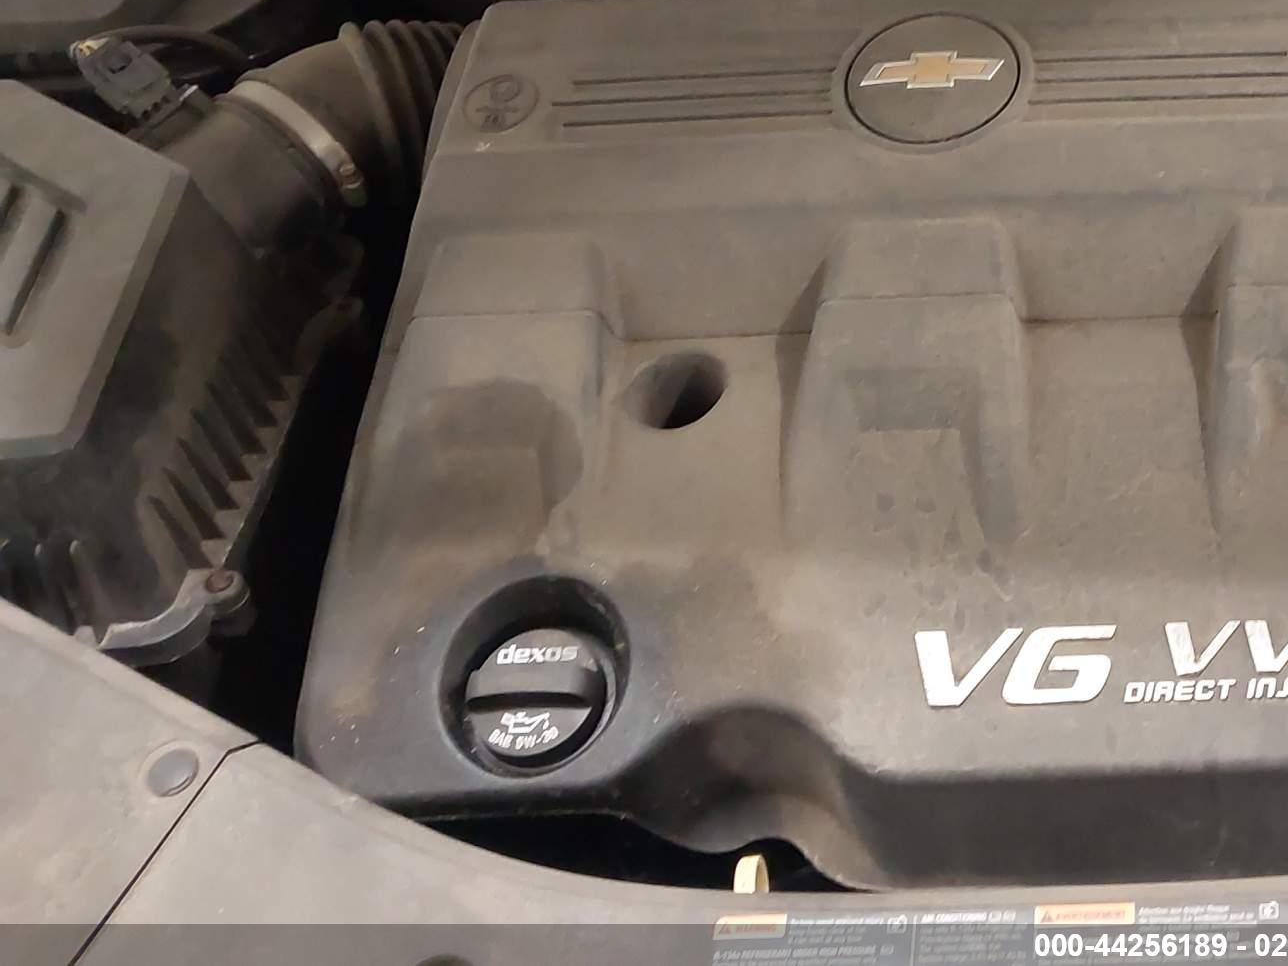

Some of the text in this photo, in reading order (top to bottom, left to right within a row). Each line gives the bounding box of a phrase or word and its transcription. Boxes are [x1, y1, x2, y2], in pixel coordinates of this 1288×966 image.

[496, 644, 579, 665] dexos
[914, 625, 1117, 707] V6
[1123, 677, 1236, 704] DIRECT
